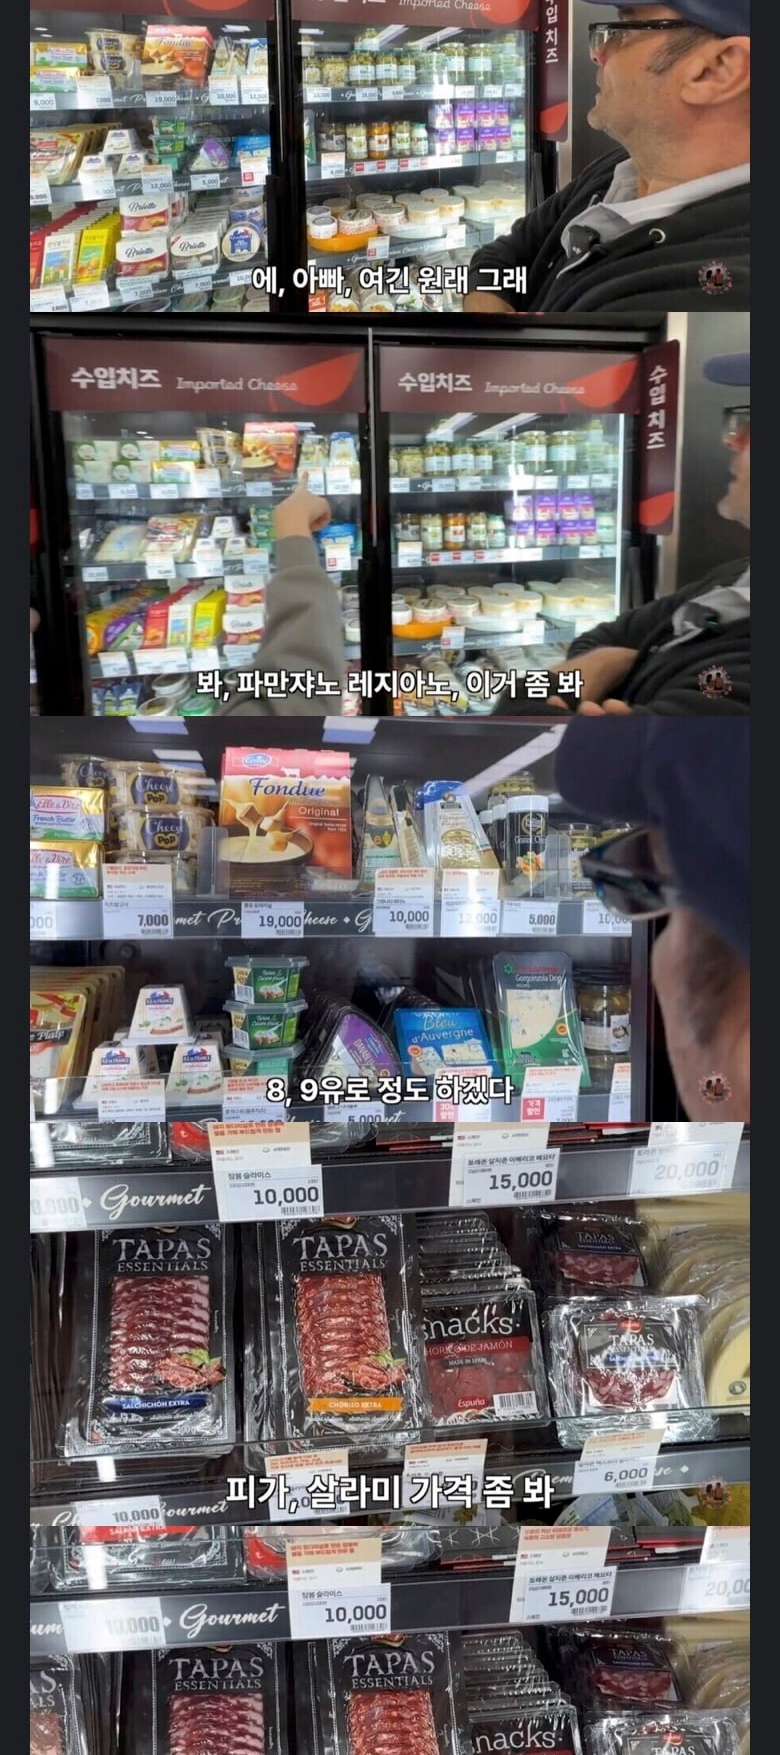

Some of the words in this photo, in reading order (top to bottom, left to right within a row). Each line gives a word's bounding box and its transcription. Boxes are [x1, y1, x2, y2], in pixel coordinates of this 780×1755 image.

[70, 366, 162, 390] 수입치즈
[176, 377, 243, 393] Imported
[398, 372, 473, 393] 수입치즈
[647, 364, 668, 450] 수입치즈
[249, 777, 327, 797] Fondue
[298, 807, 340, 817] Original
[138, 915, 169, 927] 7,000
[259, 915, 301, 929] 19,000
[390, 910, 429, 923] 10,000
[529, 914, 556, 926] 5,000
[423, 1013, 457, 1031] Bleu
[412, 1027, 474, 1043] d'Auvergne
[654, 1160, 719, 1181] 20,000
[489, 1170, 553, 1192] 15,000
[101, 1183, 212, 1220] Gourmet
[254, 1186, 319, 1206] 10,000
[112, 1238, 211, 1261] TAPAS
[293, 1233, 388, 1260] TAPAS
[118, 1261, 208, 1272] ESSENTIALS
[300, 1259, 386, 1272] ESSENTIALS
[609, 1334, 654, 1346] TAPAS
[122, 1401, 167, 1409] SALCHICHÓN
[168, 1400, 190, 1408] EXTRA
[458, 1398, 485, 1408] Espuña
[604, 1467, 648, 1483] 6,000
[113, 1508, 160, 1523] 10,000
[548, 1588, 609, 1608] 15,000
[179, 1603, 286, 1639] Gourmet
[325, 1604, 387, 1624] 10,000
[168, 1657, 264, 1680] TAPAS
[343, 1650, 435, 1678] TAPAS
[175, 1679, 262, 1691] ESSENTIALS
[352, 1675, 433, 1689] ESSENTIALS
